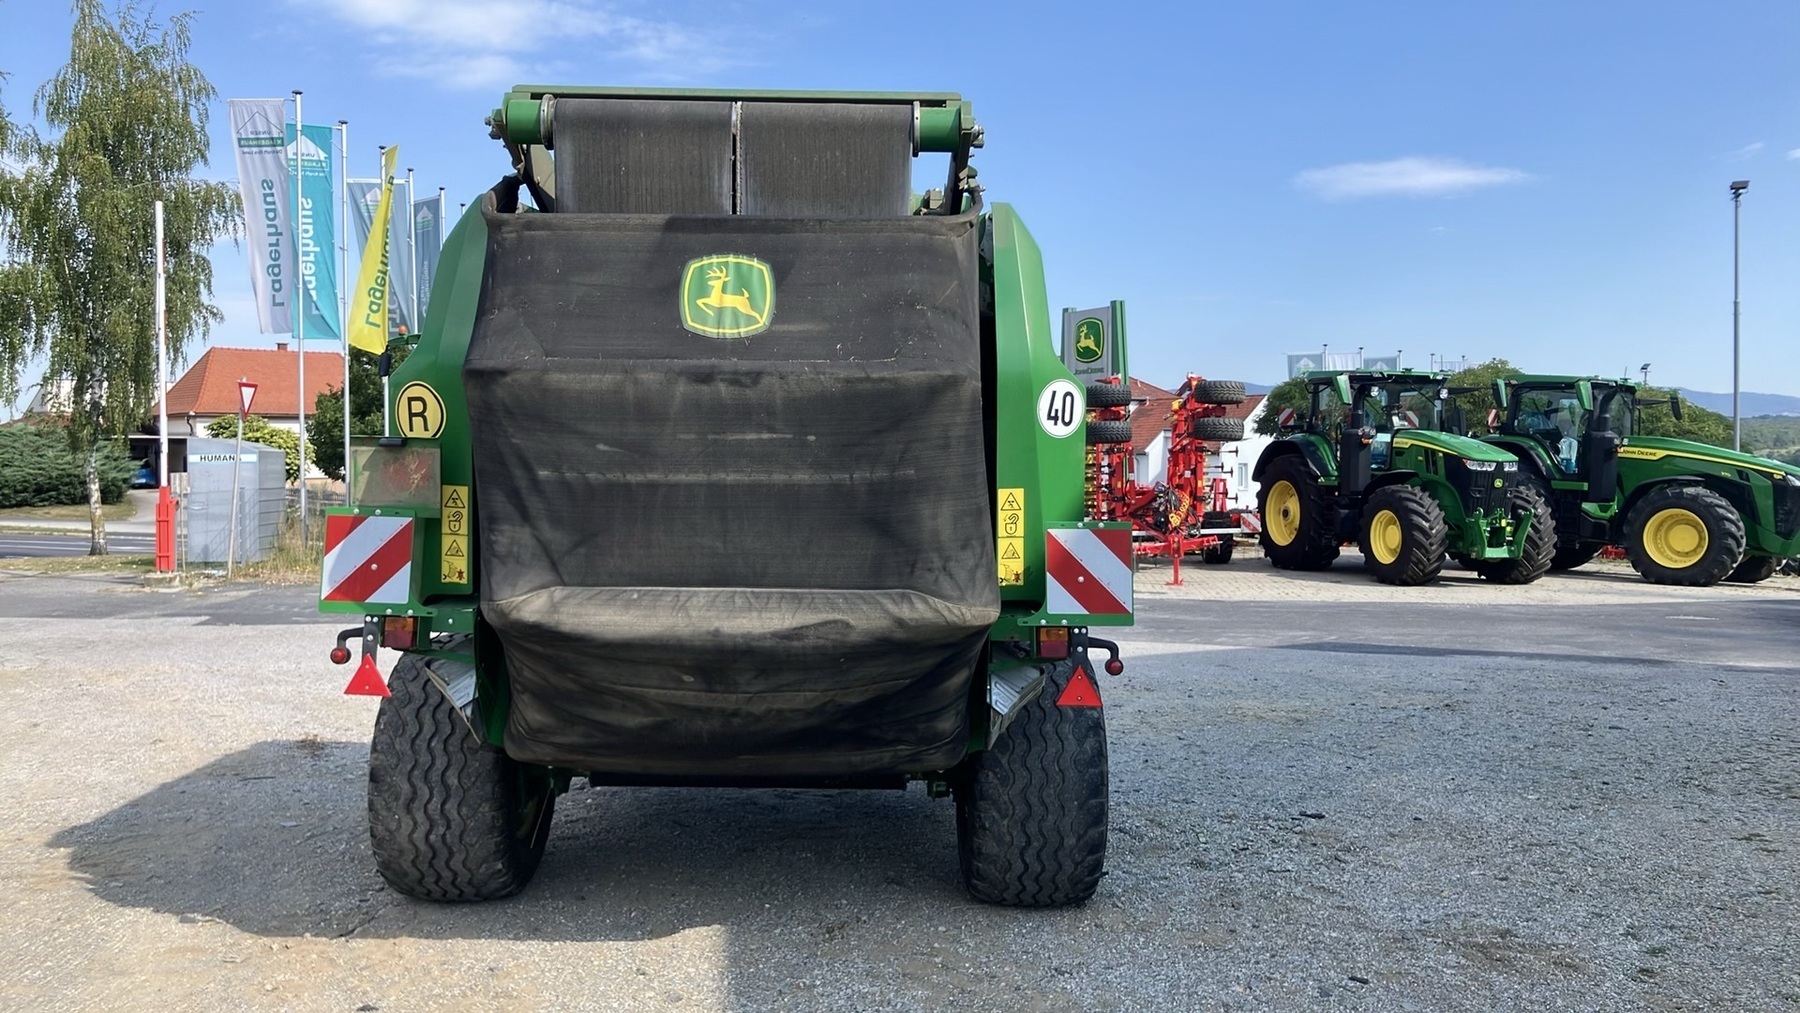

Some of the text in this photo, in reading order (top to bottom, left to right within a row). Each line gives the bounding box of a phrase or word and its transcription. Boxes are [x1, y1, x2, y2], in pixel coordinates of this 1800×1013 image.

[407, 396, 430, 433] R
[1046, 390, 1075, 427] 40
[1637, 449, 1658, 457] DEERE
